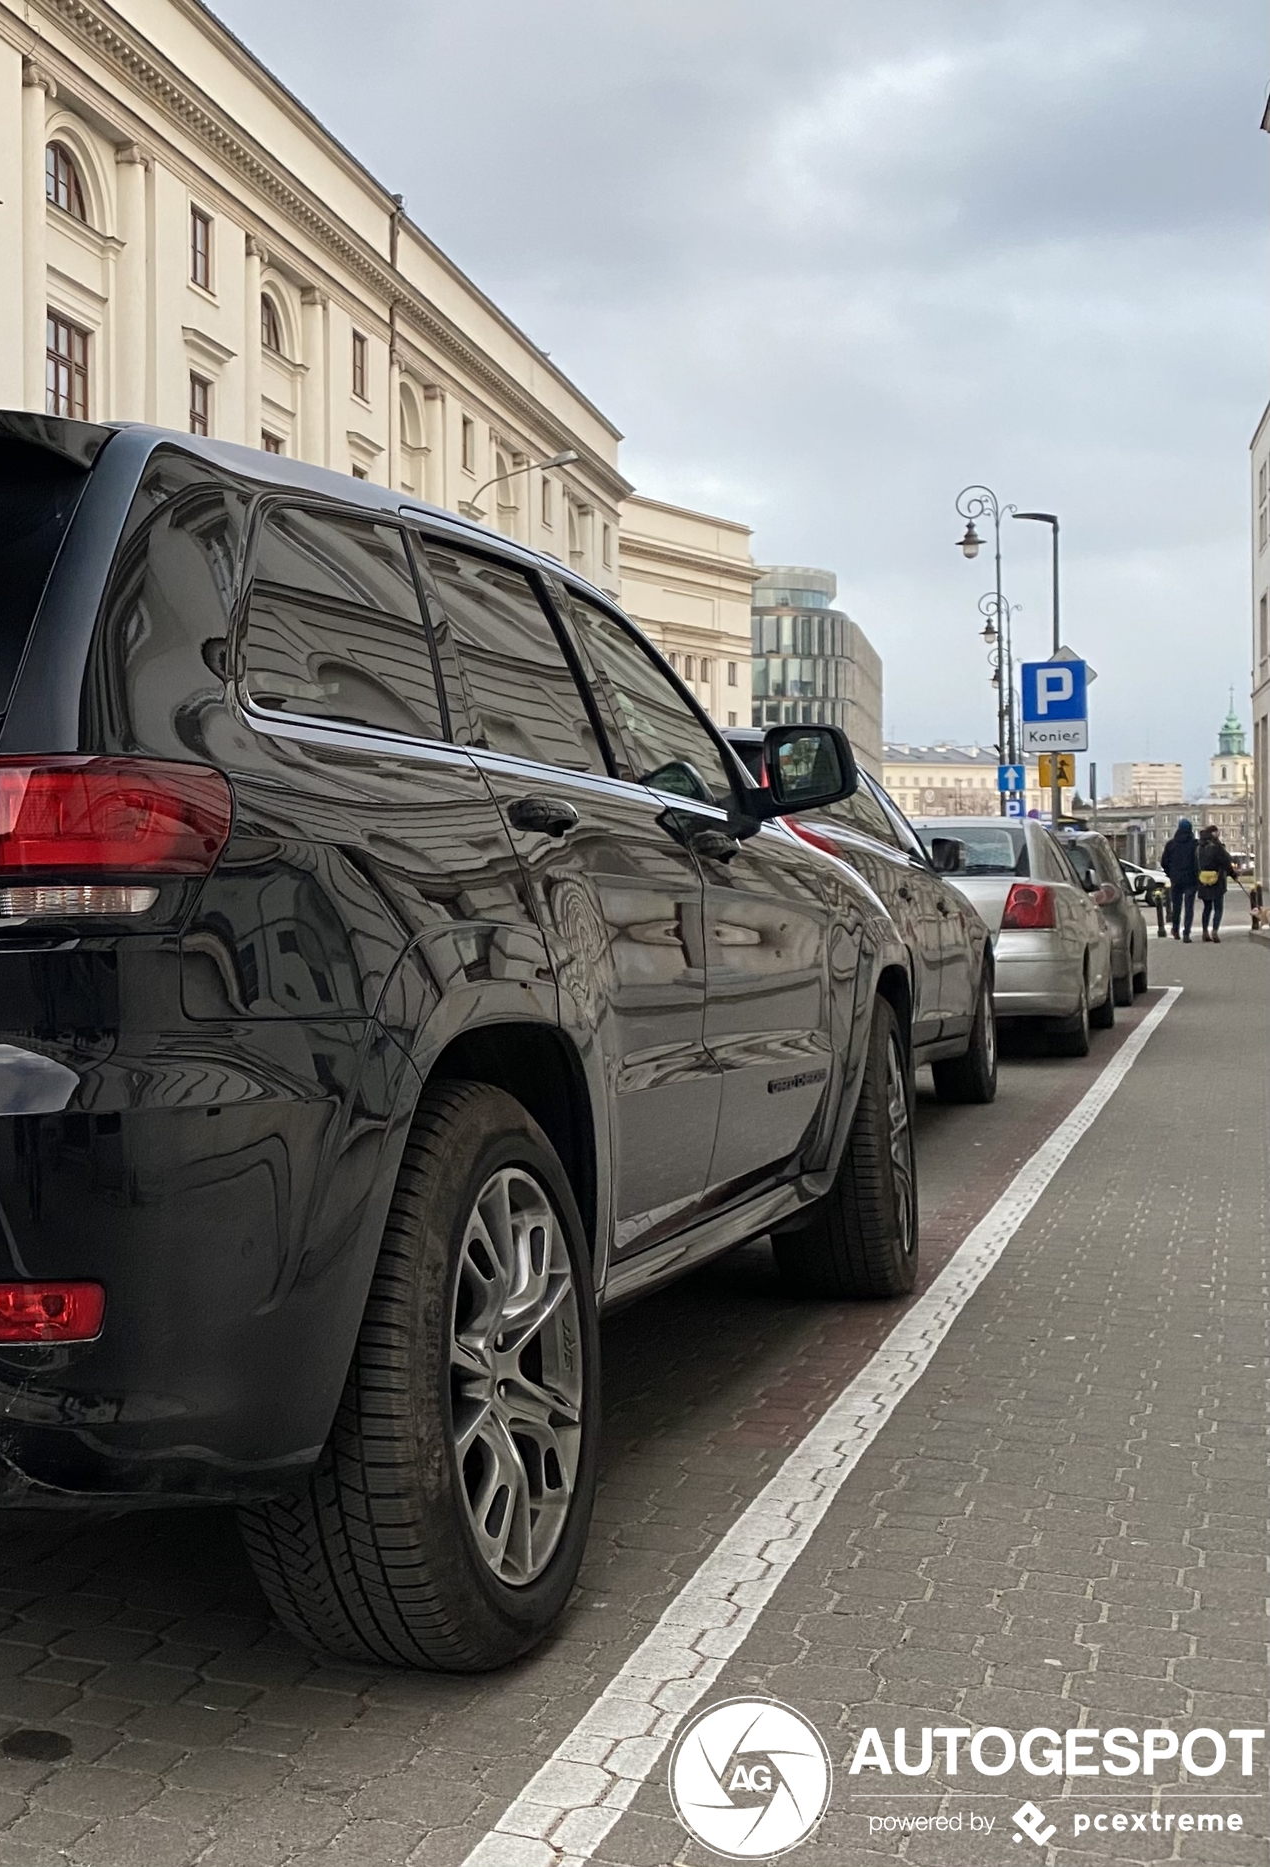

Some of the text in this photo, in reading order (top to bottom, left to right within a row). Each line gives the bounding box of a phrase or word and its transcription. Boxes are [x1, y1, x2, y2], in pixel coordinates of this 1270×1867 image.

[1037, 668, 1073, 715] P
[1029, 731, 1080, 742] Koniec
[1006, 801, 1020, 817] P
